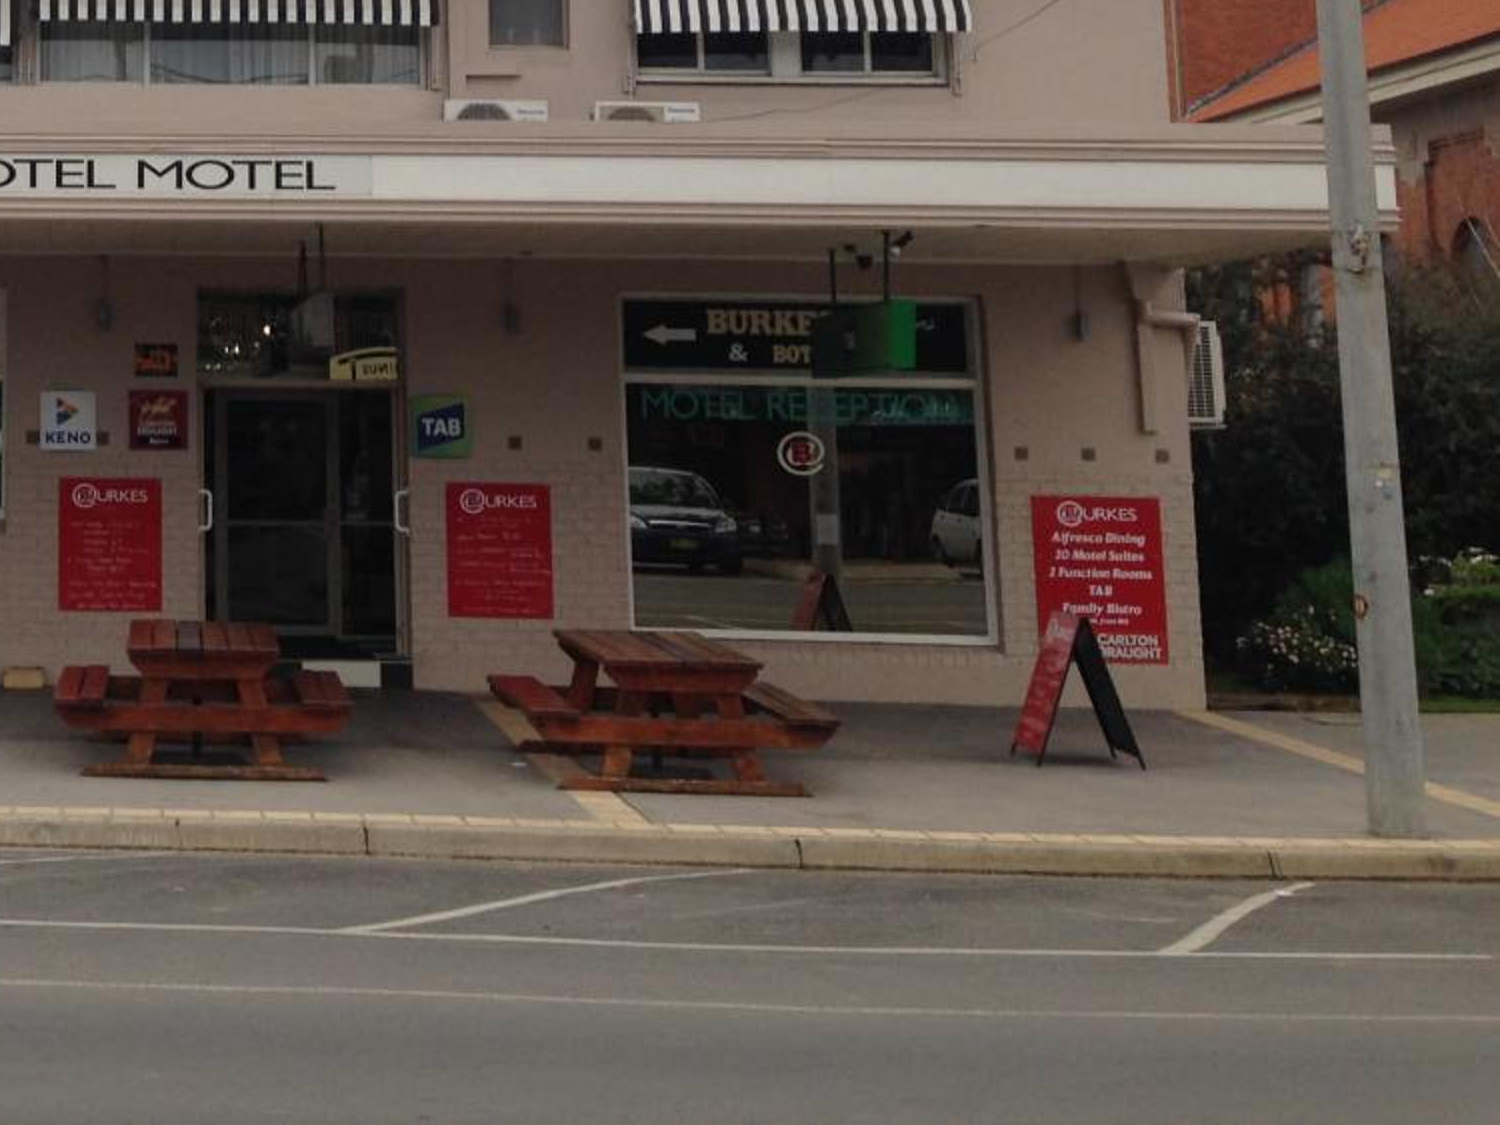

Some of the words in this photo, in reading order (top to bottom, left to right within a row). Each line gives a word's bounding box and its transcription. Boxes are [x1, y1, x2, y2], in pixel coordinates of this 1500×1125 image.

[136, 159, 337, 191] MOTEL
[707, 308, 837, 336] BURKE
[728, 345, 748, 363] &
[422, 417, 461, 438] TAB
[45, 431, 91, 444] KENO
[1105, 533, 1146, 548] Dining
[1072, 550, 1106, 562] Motel
[1058, 567, 1110, 579] Function
[1112, 569, 1153, 580] Rooms
[1097, 634, 1159, 646] CARLTON
